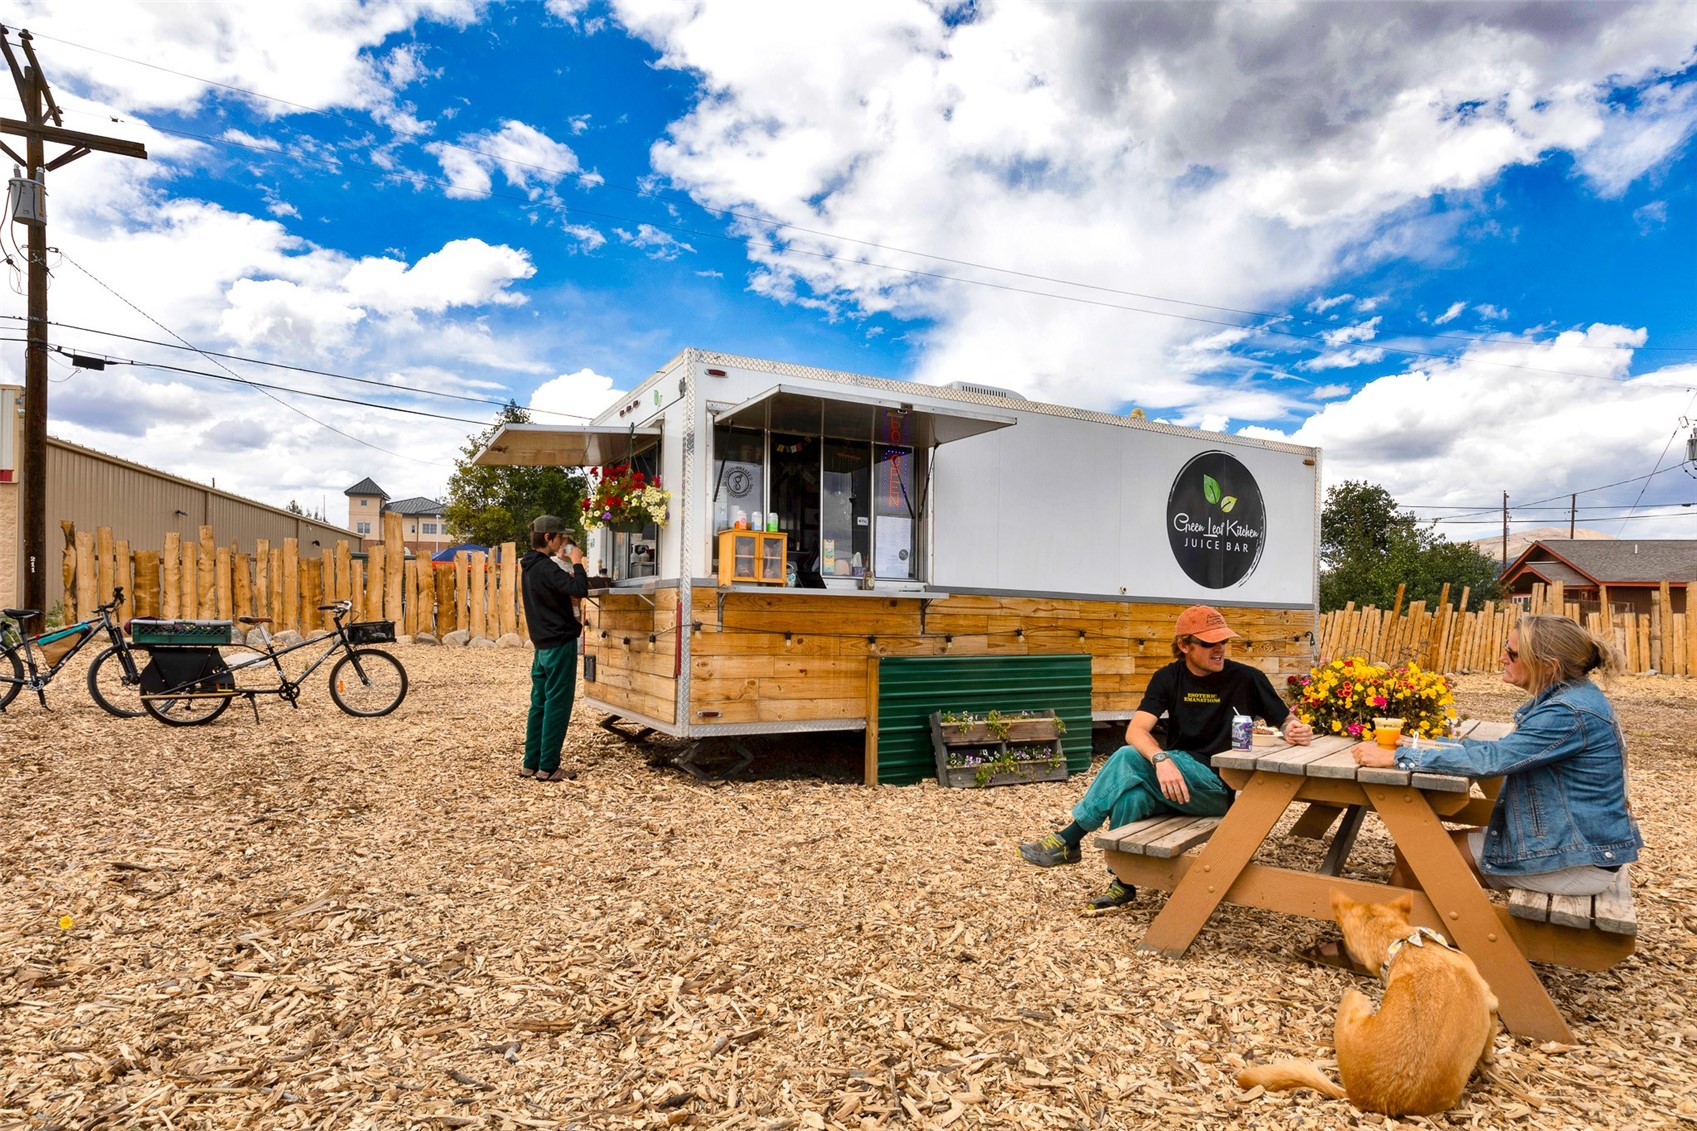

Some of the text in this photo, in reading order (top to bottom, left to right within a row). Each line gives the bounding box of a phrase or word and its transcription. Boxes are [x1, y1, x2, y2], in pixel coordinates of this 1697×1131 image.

[889, 454, 901, 508] OPEN
[1173, 512, 1259, 538] Green Leaf Kitchen
[1184, 538, 1249, 553] JUICE BAR
